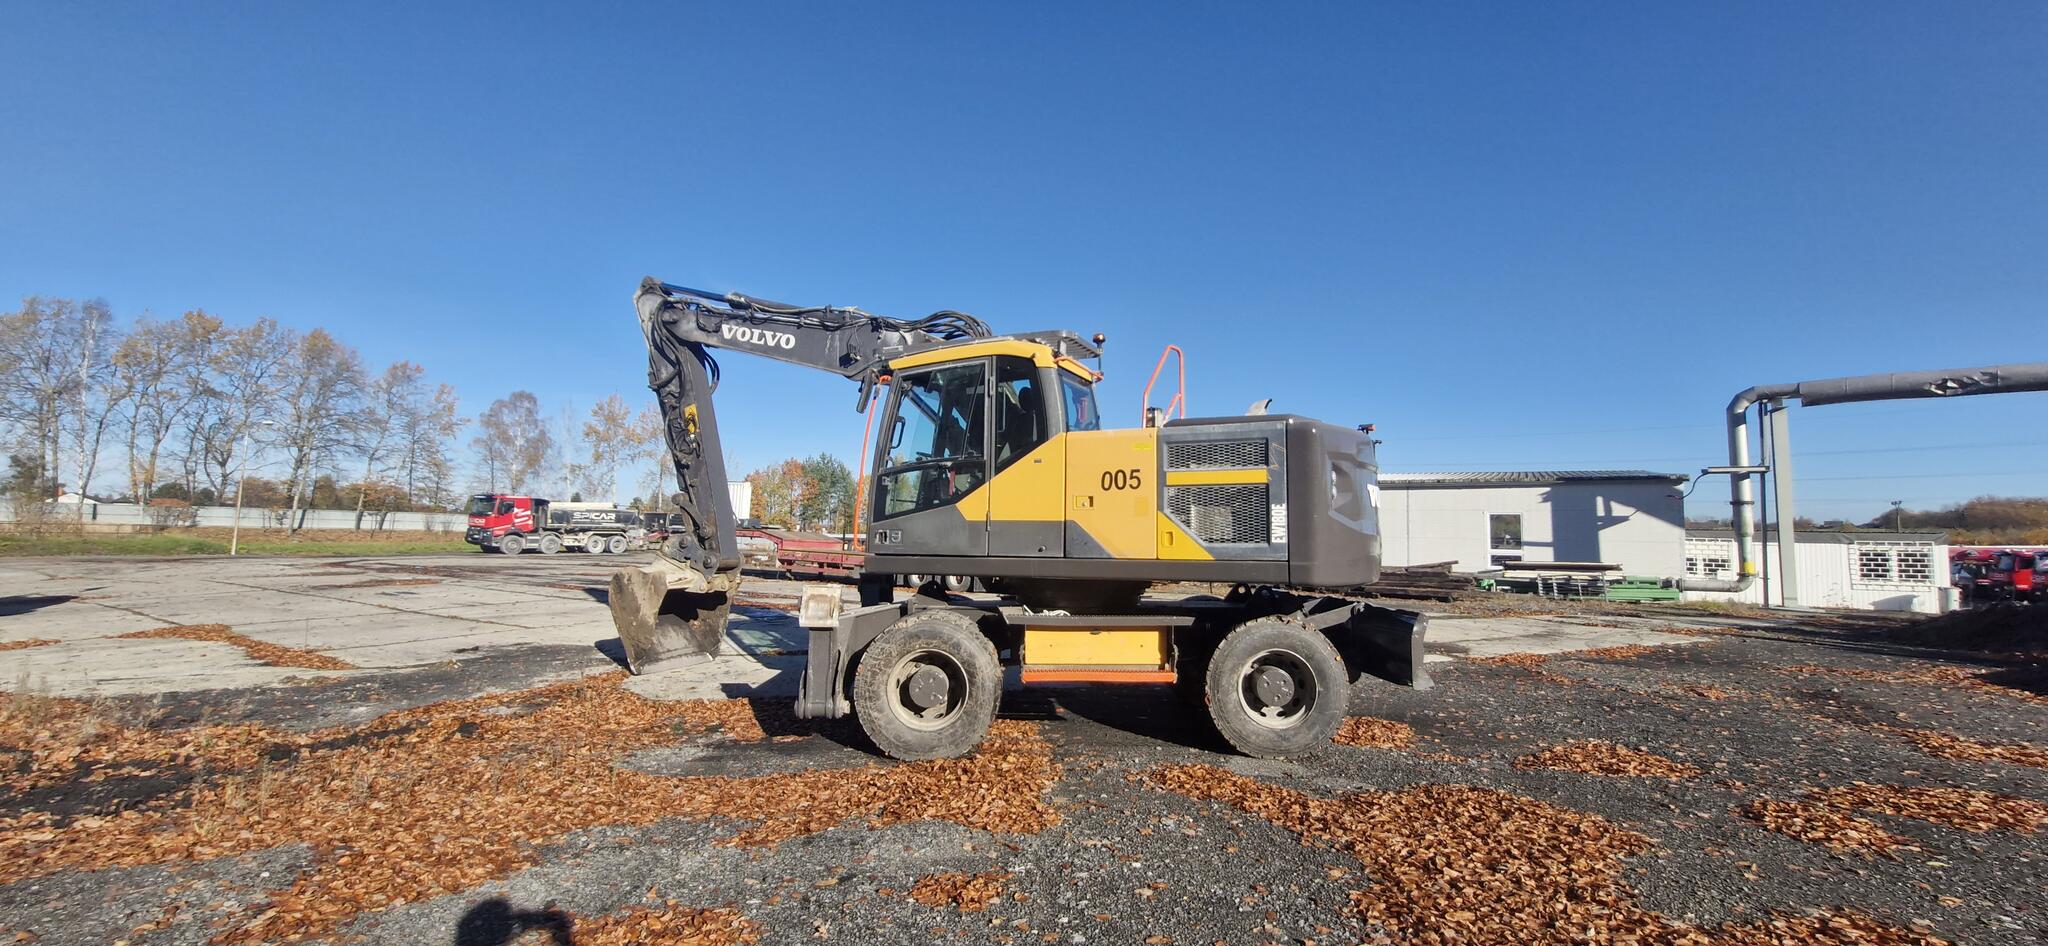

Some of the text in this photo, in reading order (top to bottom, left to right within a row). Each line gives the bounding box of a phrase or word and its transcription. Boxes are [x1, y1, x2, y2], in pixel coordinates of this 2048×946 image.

[721, 323, 796, 349] VOLVO
[1100, 468, 1142, 491] 005
[572, 511, 616, 520] SPICAR
[1271, 503, 1287, 543] EW180E
